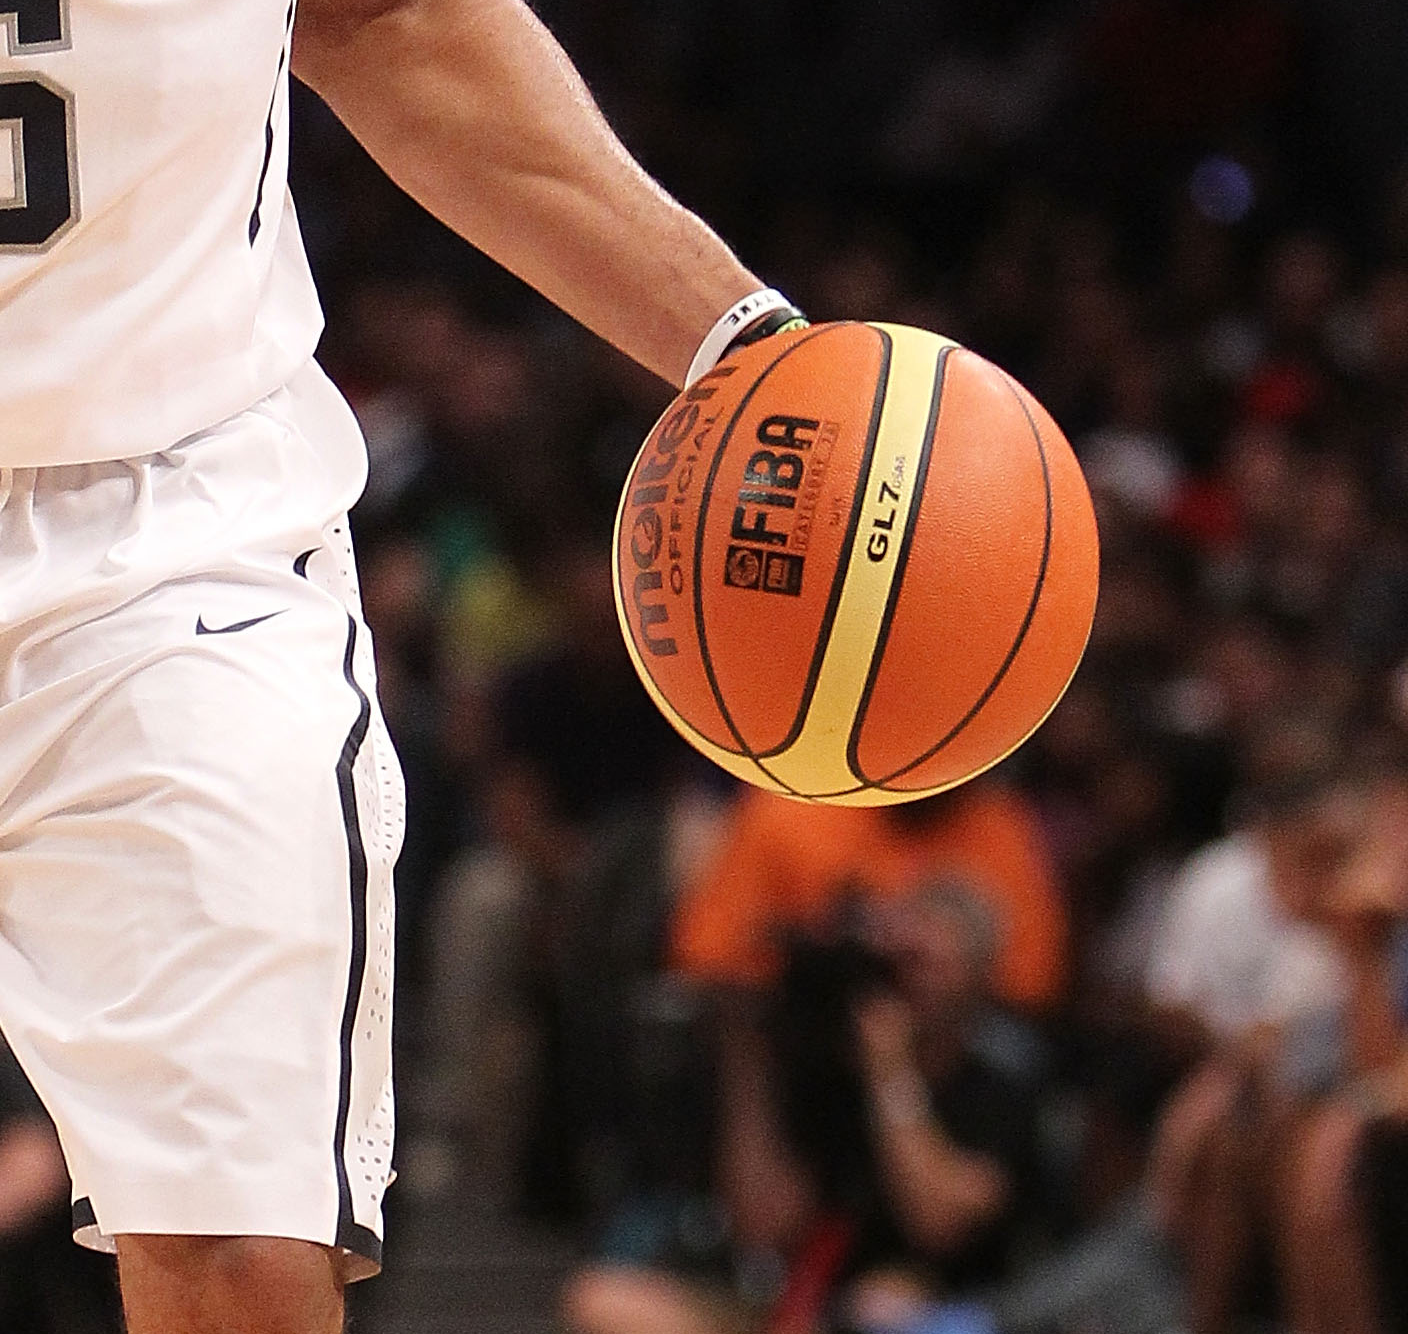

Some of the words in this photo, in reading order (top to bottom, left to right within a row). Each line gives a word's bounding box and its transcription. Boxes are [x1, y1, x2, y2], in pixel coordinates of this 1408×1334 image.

[631, 367, 740, 657] molten
[668, 406, 725, 595] OFFICIAL
[731, 414, 821, 547] FIBA
[867, 481, 900, 562] GL7
